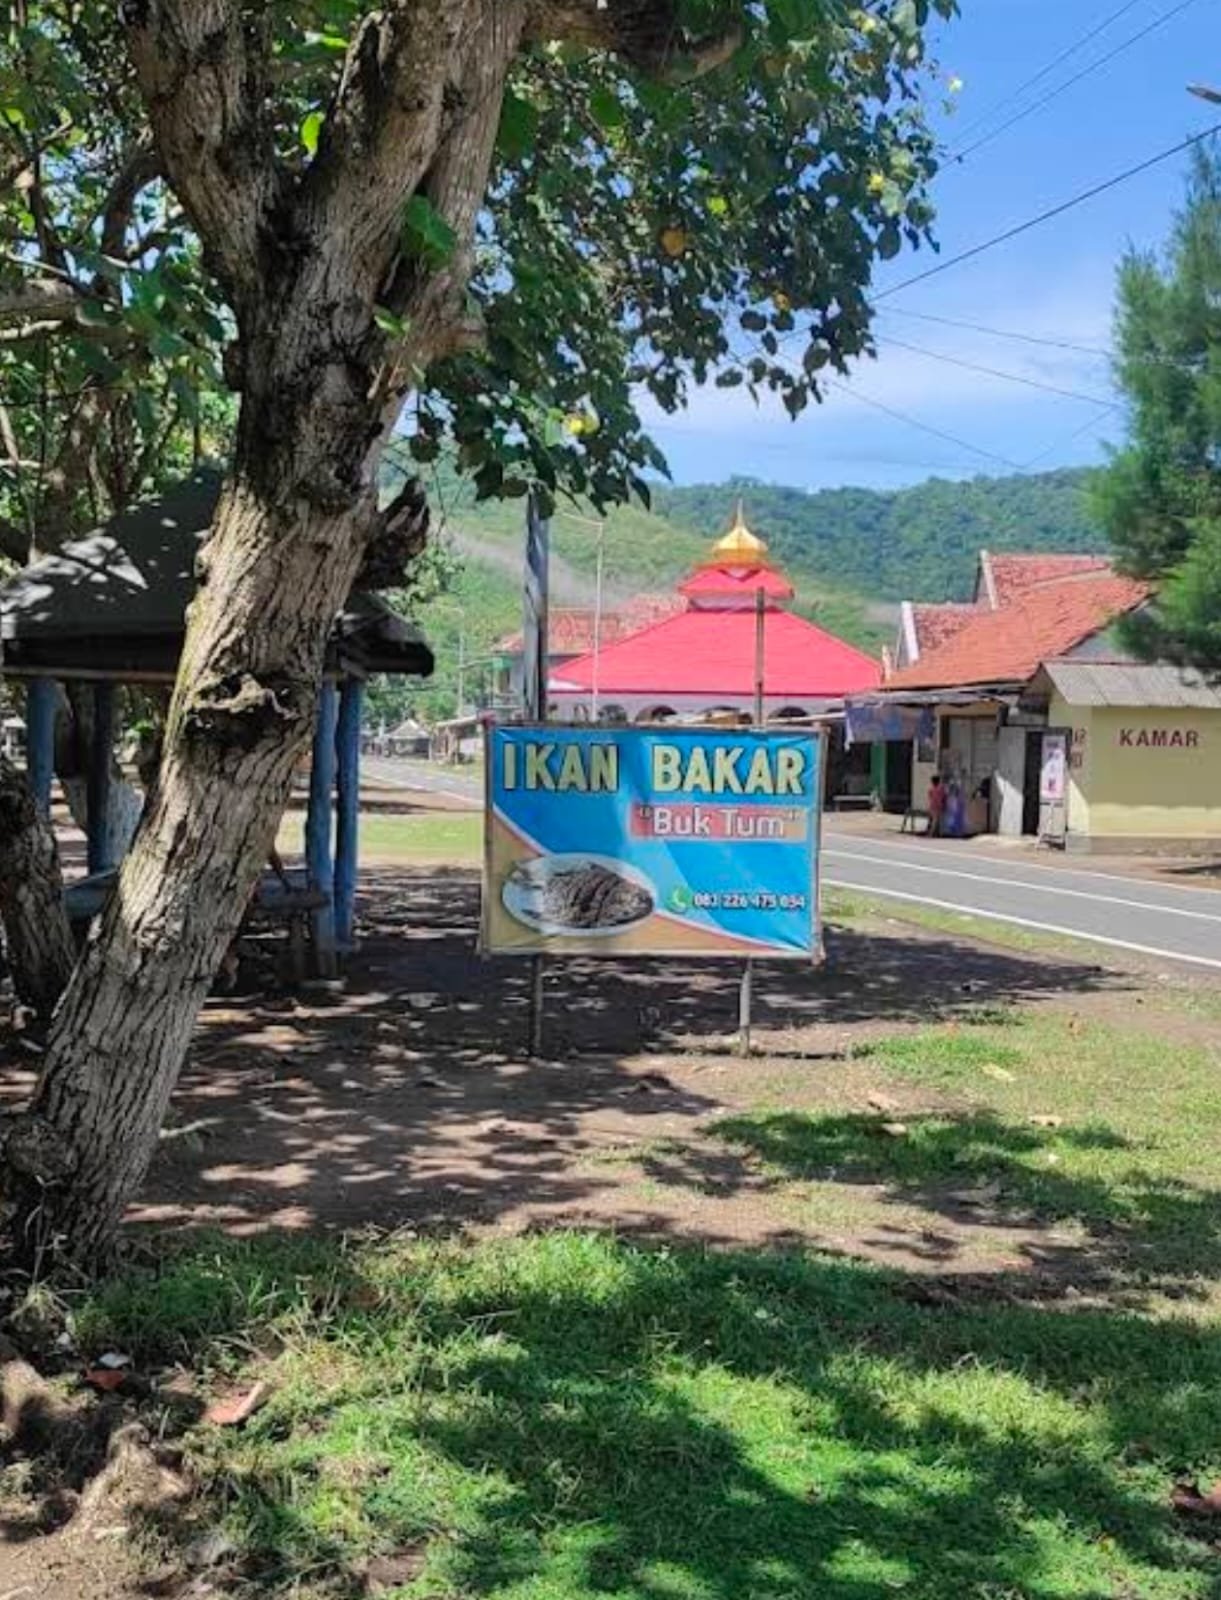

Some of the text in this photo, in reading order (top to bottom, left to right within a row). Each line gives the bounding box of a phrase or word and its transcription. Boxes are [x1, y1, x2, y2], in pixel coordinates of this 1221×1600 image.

[1119, 729, 1199, 747] KAMAR
[502, 742, 805, 794] IKAN BAKAR
